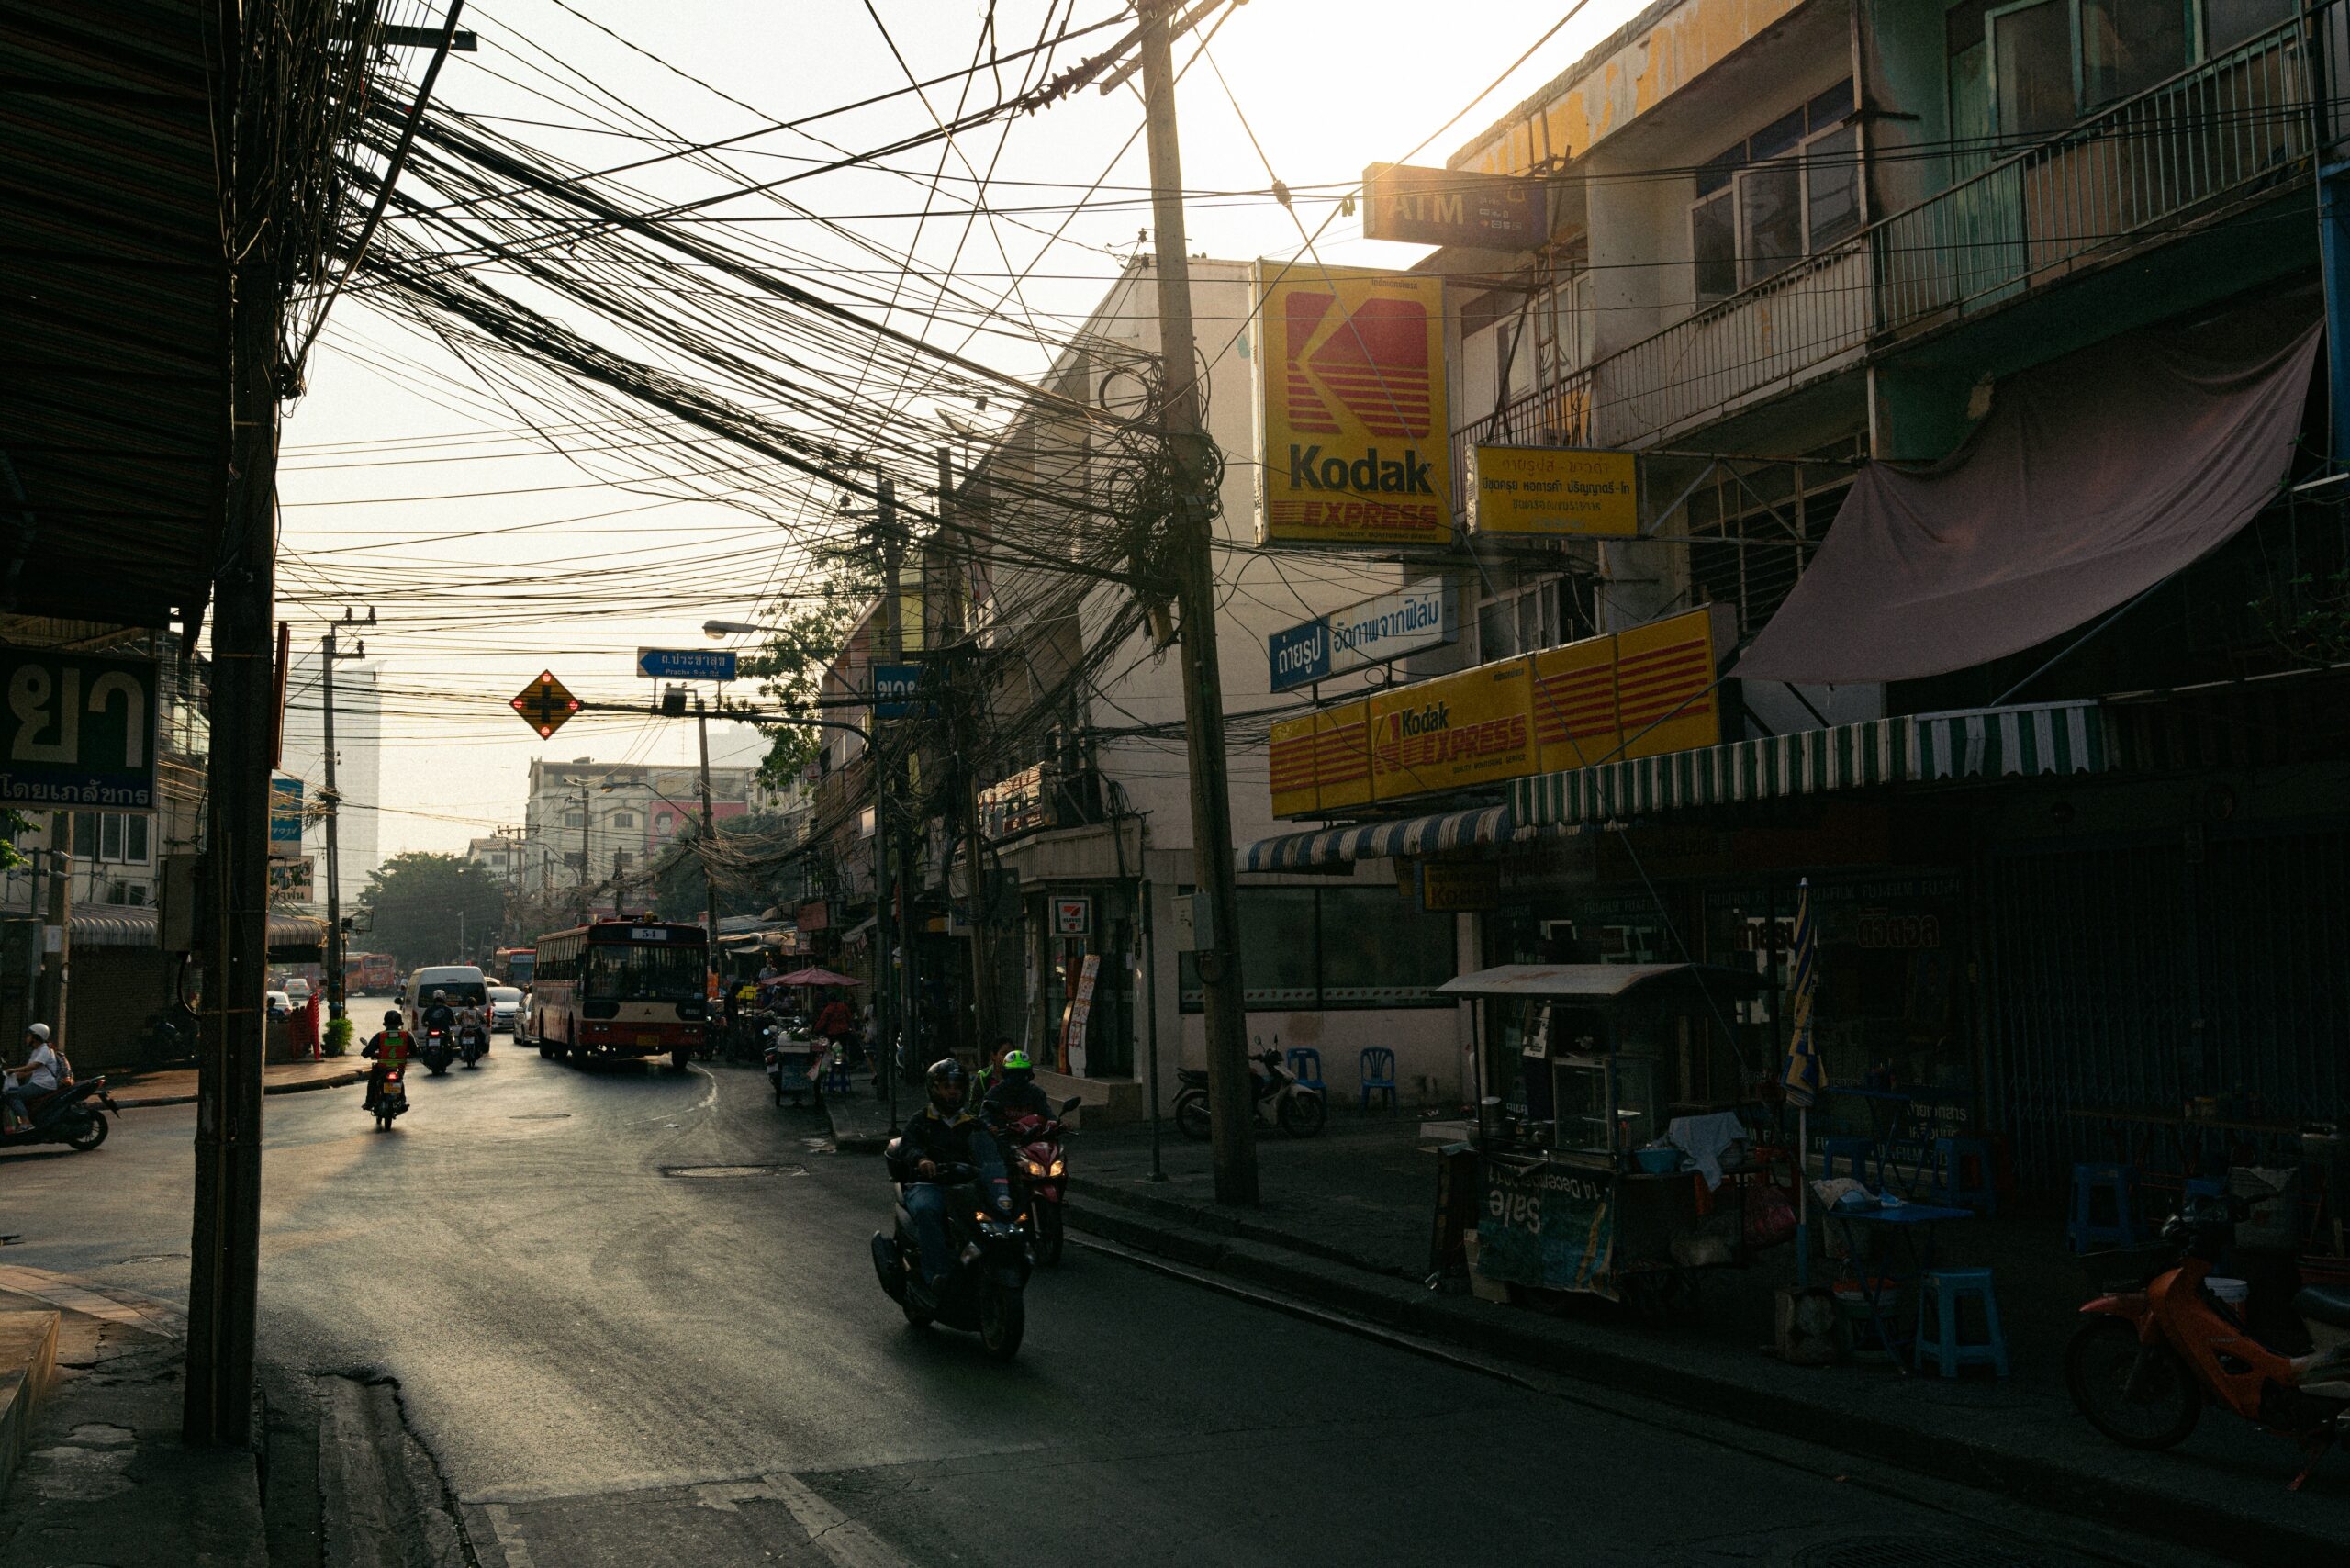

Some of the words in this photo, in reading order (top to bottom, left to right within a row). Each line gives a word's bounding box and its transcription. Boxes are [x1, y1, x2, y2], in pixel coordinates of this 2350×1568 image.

[1387, 191, 1464, 225] ATM
[1290, 443, 1434, 496] Kodak
[1523, 478, 1562, 493] หอการค้า
[1304, 500, 1438, 531] EXPRESS
[1334, 594, 1438, 653] อัดภาพจากฟิล์ม
[661, 654, 725, 669] ถ.ประชาสุข
[1278, 626, 1322, 675] ถ่ายรูป
[8, 663, 145, 768] ยา
[1402, 699, 1451, 737] Kodak
[1422, 713, 1528, 765] EXPRESS
[1453, 764, 1471, 775] QUALITY
[1505, 753, 1527, 765] SERVICE
[1062, 905, 1081, 917] 7
[1582, 1180, 1601, 1201] 14
[1488, 1189, 1541, 1235] Sale
